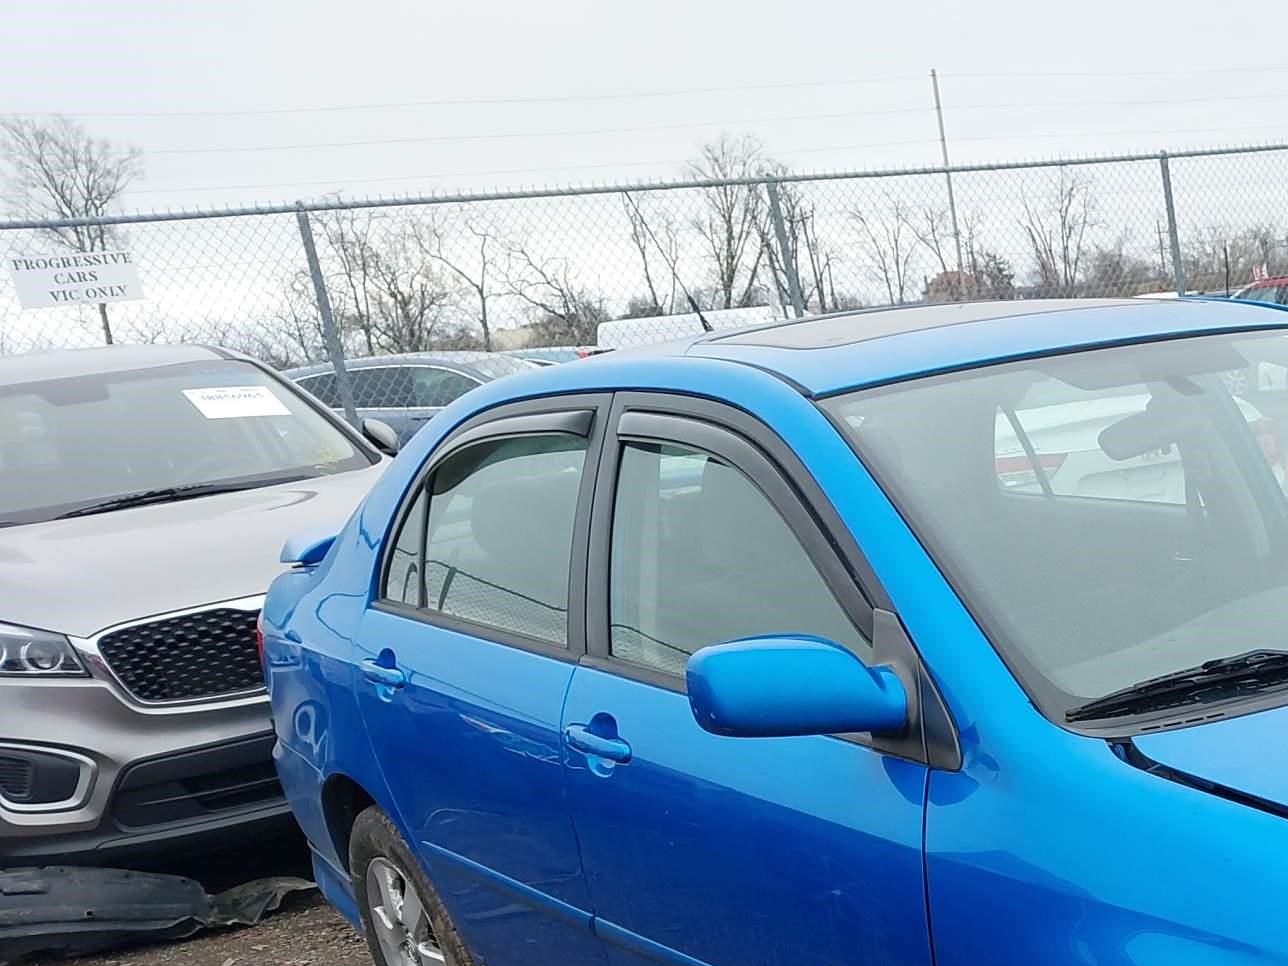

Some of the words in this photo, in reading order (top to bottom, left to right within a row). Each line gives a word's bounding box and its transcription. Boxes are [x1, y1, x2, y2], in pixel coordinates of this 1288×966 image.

[12, 252, 133, 271] PROGRESSIVE
[53, 270, 99, 285] CARS
[49, 288, 80, 302] VIC
[85, 285, 128, 299] ONLY
